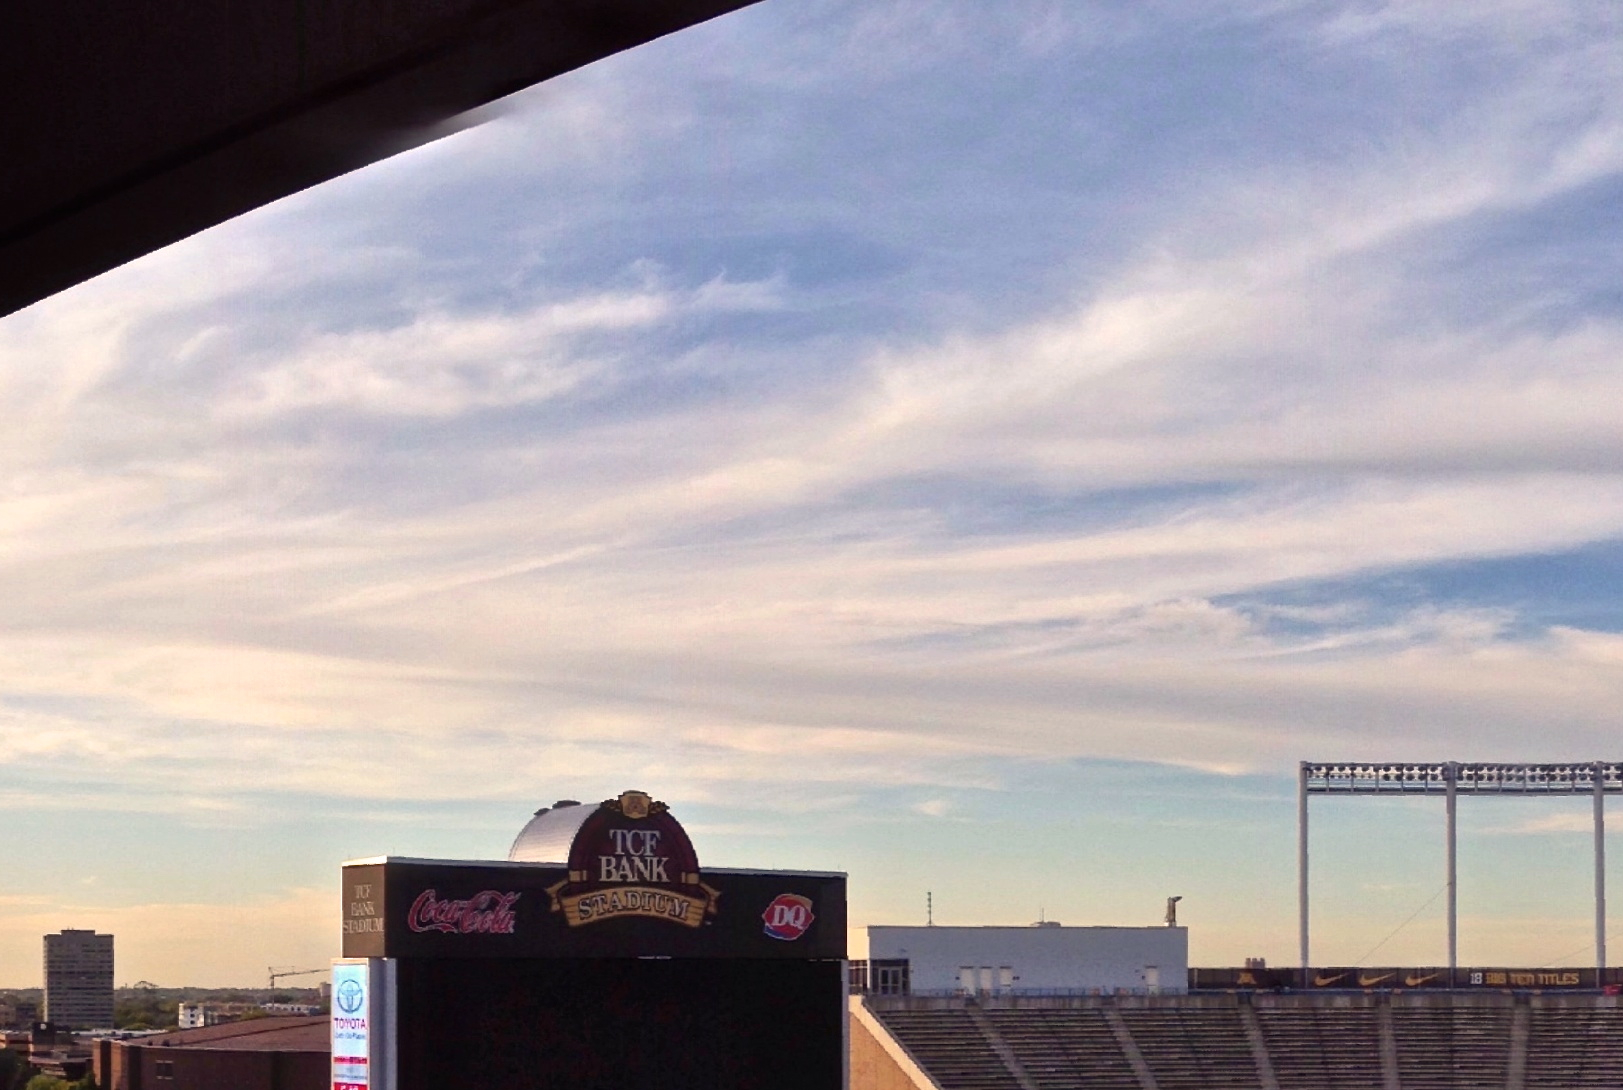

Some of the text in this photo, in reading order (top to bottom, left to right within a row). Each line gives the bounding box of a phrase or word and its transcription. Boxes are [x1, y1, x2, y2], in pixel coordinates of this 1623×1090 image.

[609, 829, 661, 856] TCF
[598, 855, 670, 882] BANK
[408, 888, 521, 933] Coca-Cola
[579, 887, 690, 921] STADIUM
[772, 905, 809, 929] DQ
[342, 919, 385, 934] STADIUM
[334, 1017, 366, 1029] TOYOTA
